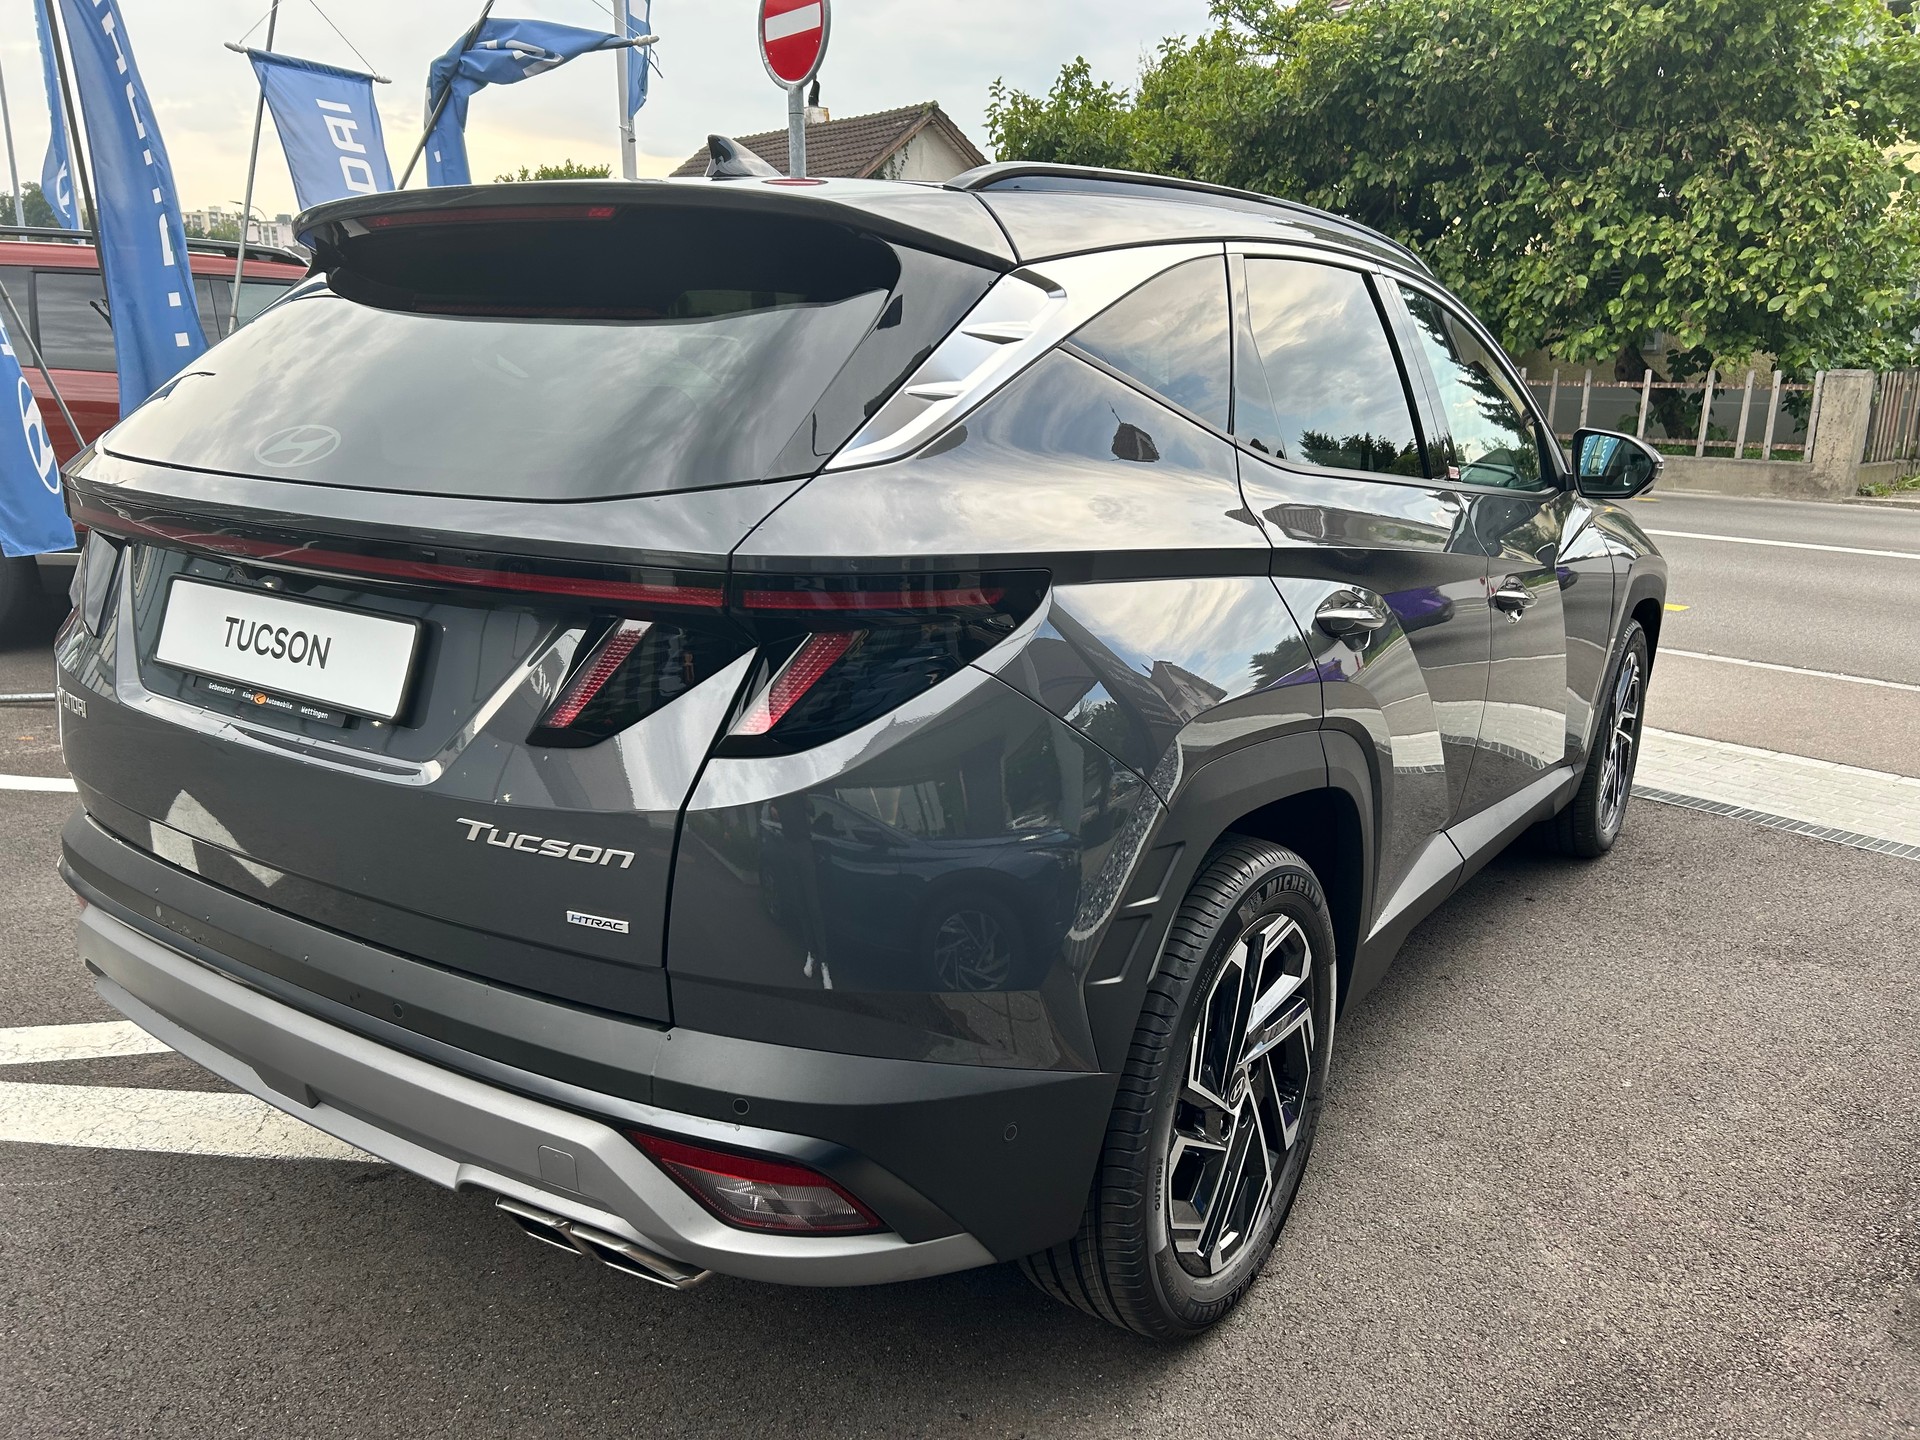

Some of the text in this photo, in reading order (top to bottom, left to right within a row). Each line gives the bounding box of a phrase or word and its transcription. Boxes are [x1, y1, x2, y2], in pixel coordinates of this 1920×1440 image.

[224, 615, 332, 670] TUCSON
[301, 706, 329, 719] Wettingen
[1265, 874, 1322, 908] MICHELIN
[570, 914, 624, 931] HTRAC
[1154, 1157, 1164, 1212] OUTSIDE
